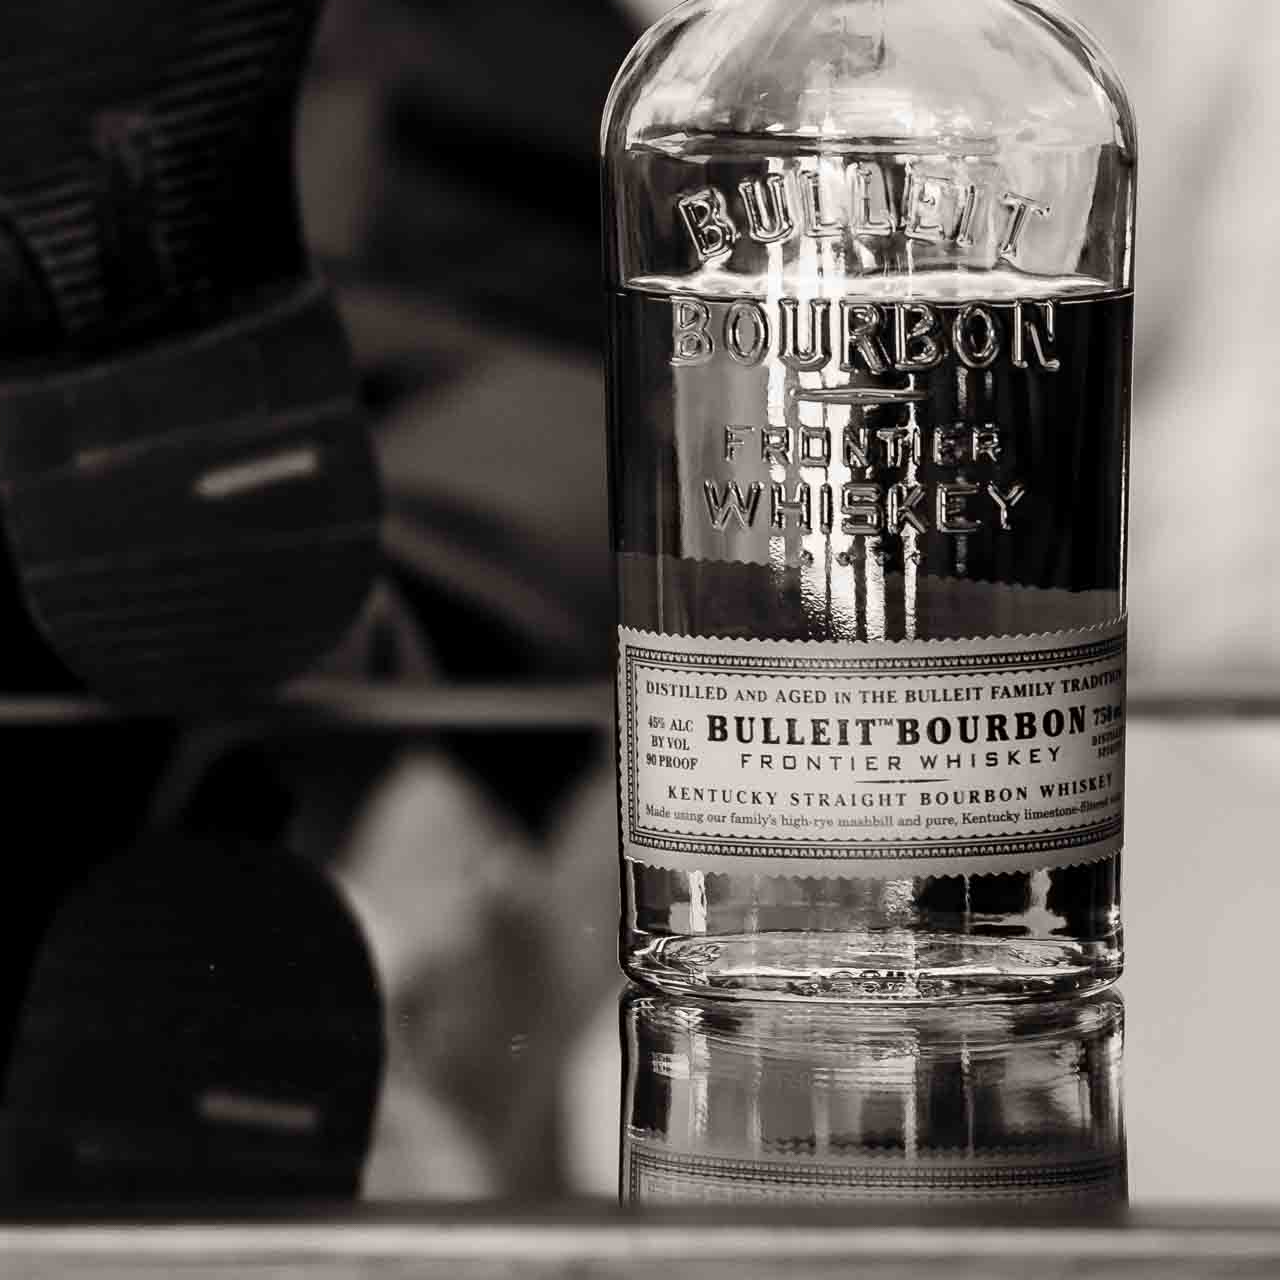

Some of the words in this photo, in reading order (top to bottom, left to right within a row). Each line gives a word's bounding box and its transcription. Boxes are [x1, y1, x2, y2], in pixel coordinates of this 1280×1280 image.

[678, 161, 1051, 263] BULLEIT
[670, 296, 1060, 376] BOURBON
[724, 423, 1003, 469] FRONTIER
[703, 480, 1025, 536] WHISKEY
[646, 679, 728, 702] DISTILLED
[734, 689, 769, 703] AND
[775, 689, 827, 704] AGED
[834, 691, 852, 704] IN
[858, 690, 897, 704] THE
[905, 687, 984, 704] BULLEIT
[991, 681, 1056, 701] FAMILY
[669, 719, 694, 733] ALC
[895, 704, 1087, 746] BOURBON
[651, 734, 665, 749] BY
[667, 736, 691, 752] VOL
[740, 753, 903, 772] FRONTIER
[919, 745, 1061, 770] WHISKEY
[646, 752, 657, 767] 90
[658, 753, 699, 771] PROOF
[668, 784, 778, 806] KENTUCKY
[789, 790, 908, 808] STRAIGHT
[919, 786, 1028, 807] BOURBON
[1039, 772, 1113, 799] WHISKEY
[645, 804, 671, 819] Made
[673, 808, 705, 824] using
[706, 813, 727, 824] our
[896, 815, 921, 827] and
[925, 816, 959, 829] pure,
[961, 809, 1020, 825] Kentucky
